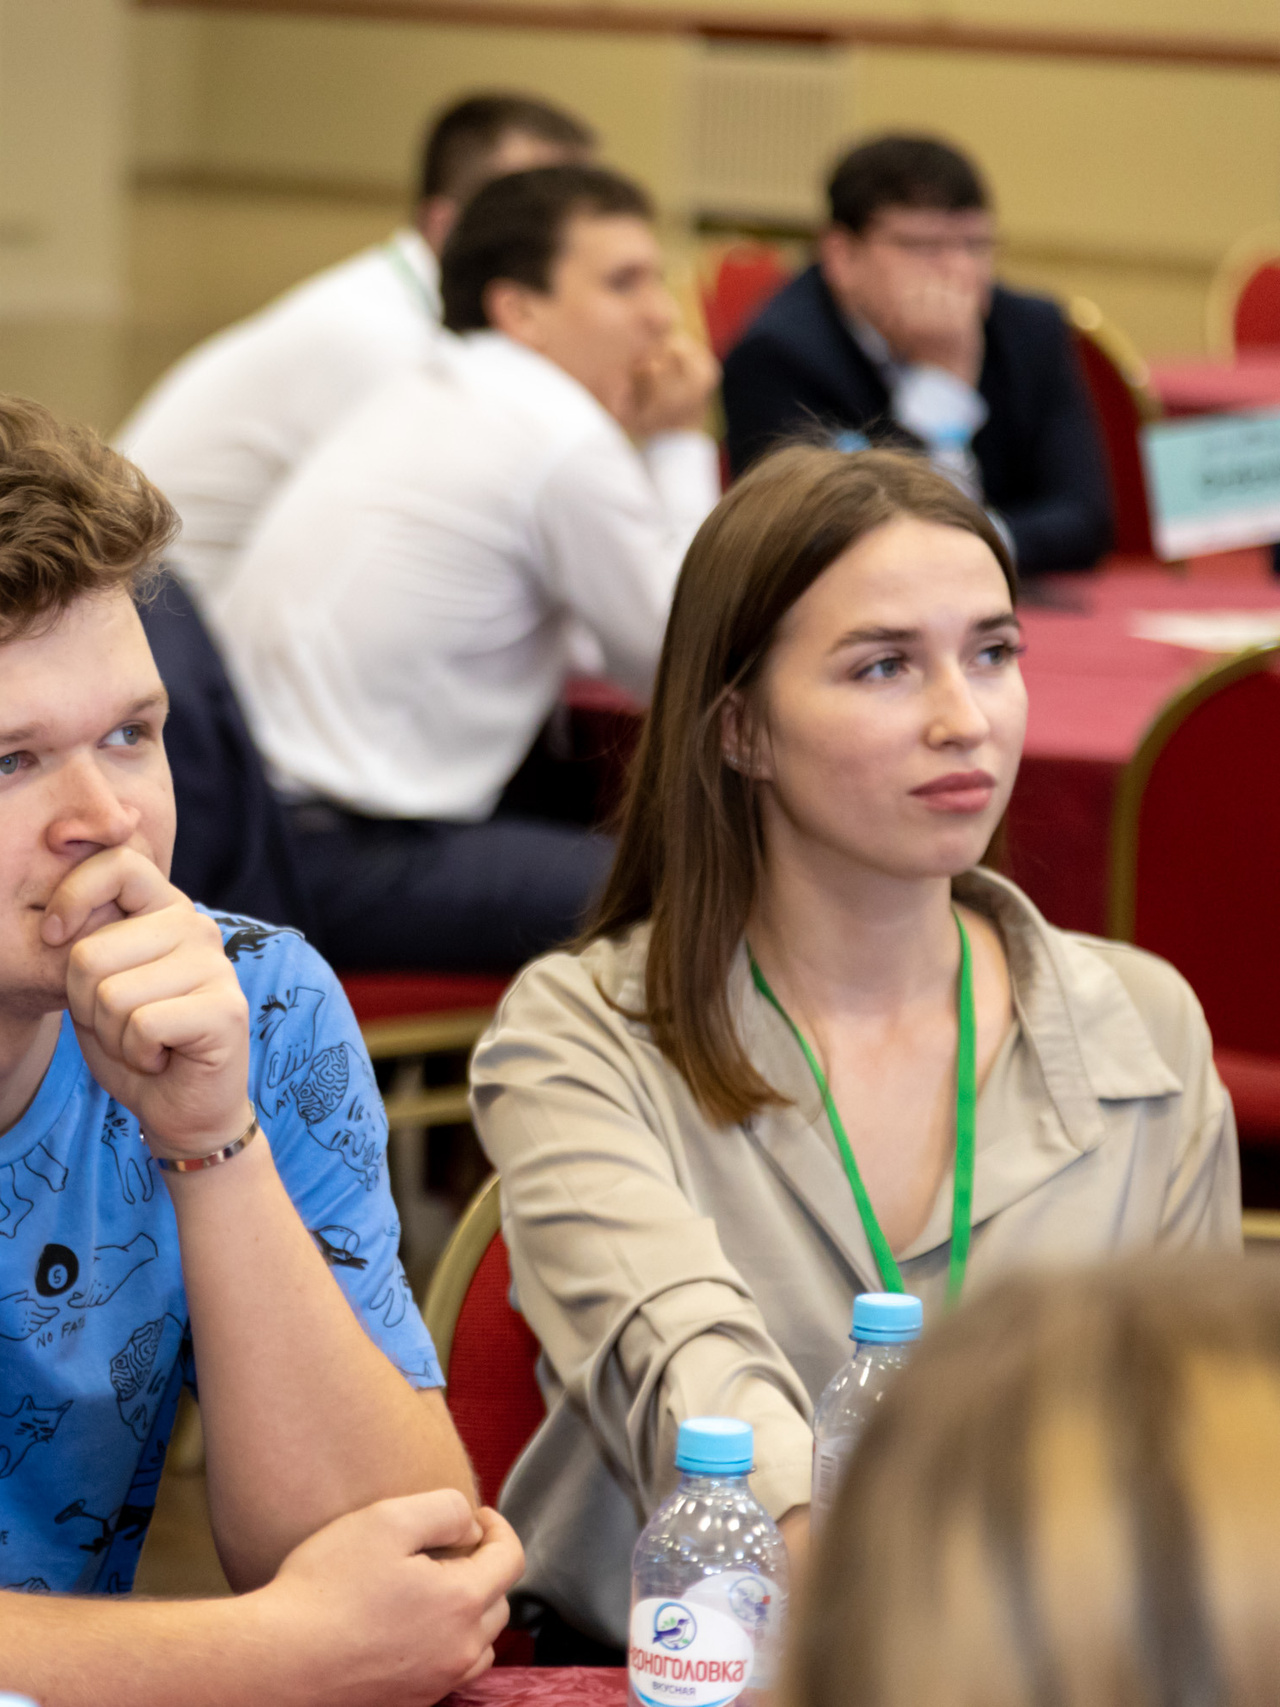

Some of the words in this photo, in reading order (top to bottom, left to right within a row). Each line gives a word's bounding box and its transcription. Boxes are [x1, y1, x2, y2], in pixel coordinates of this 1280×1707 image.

[275, 1080, 299, 1116] ATE
[36, 1332, 53, 1349] NO
[652, 1681, 696, 1696] ВКУСНАЯ
